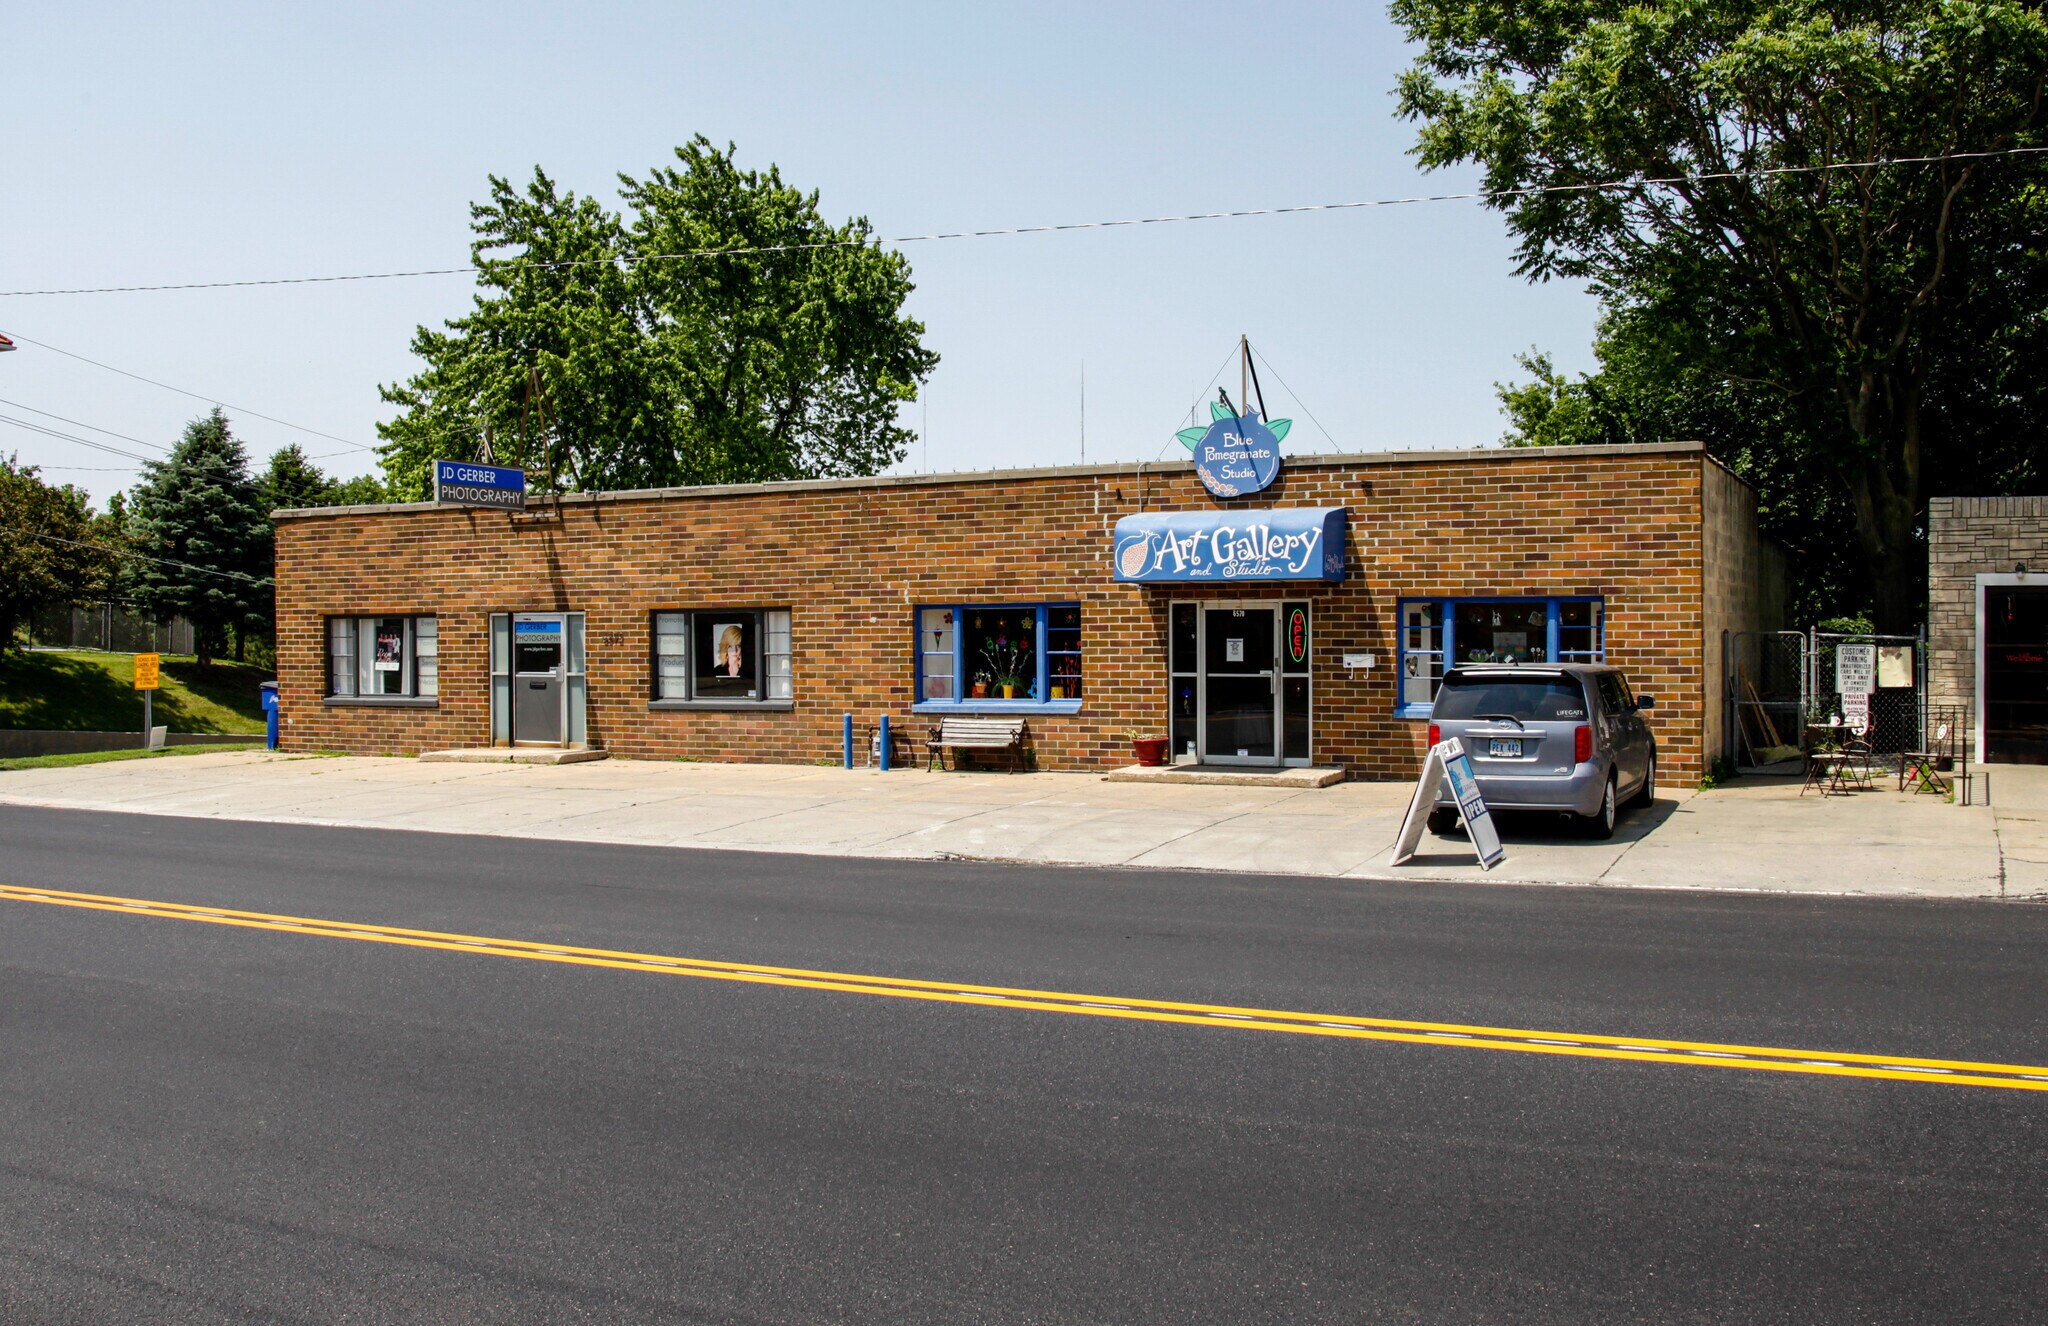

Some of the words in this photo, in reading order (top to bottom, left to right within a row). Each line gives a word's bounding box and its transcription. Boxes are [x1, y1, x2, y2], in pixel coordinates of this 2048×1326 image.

[1223, 432, 1253, 447] Blue
[1204, 447, 1270, 464] Pomegranate
[441, 466, 454, 479] JD
[457, 468, 496, 484] GERBER
[1221, 465, 1256, 479] Studio
[441, 485, 521, 504] PHOTOGRAPHY
[1154, 529, 1209, 574] Art
[1210, 524, 1322, 573] Gallery
[1190, 563, 1212, 576] and
[1223, 559, 1282, 577] Studio
[1293, 613, 1303, 657] OPEN
[1842, 647, 1870, 655] CUSTOMER
[1464, 798, 1486, 820] OPEN
